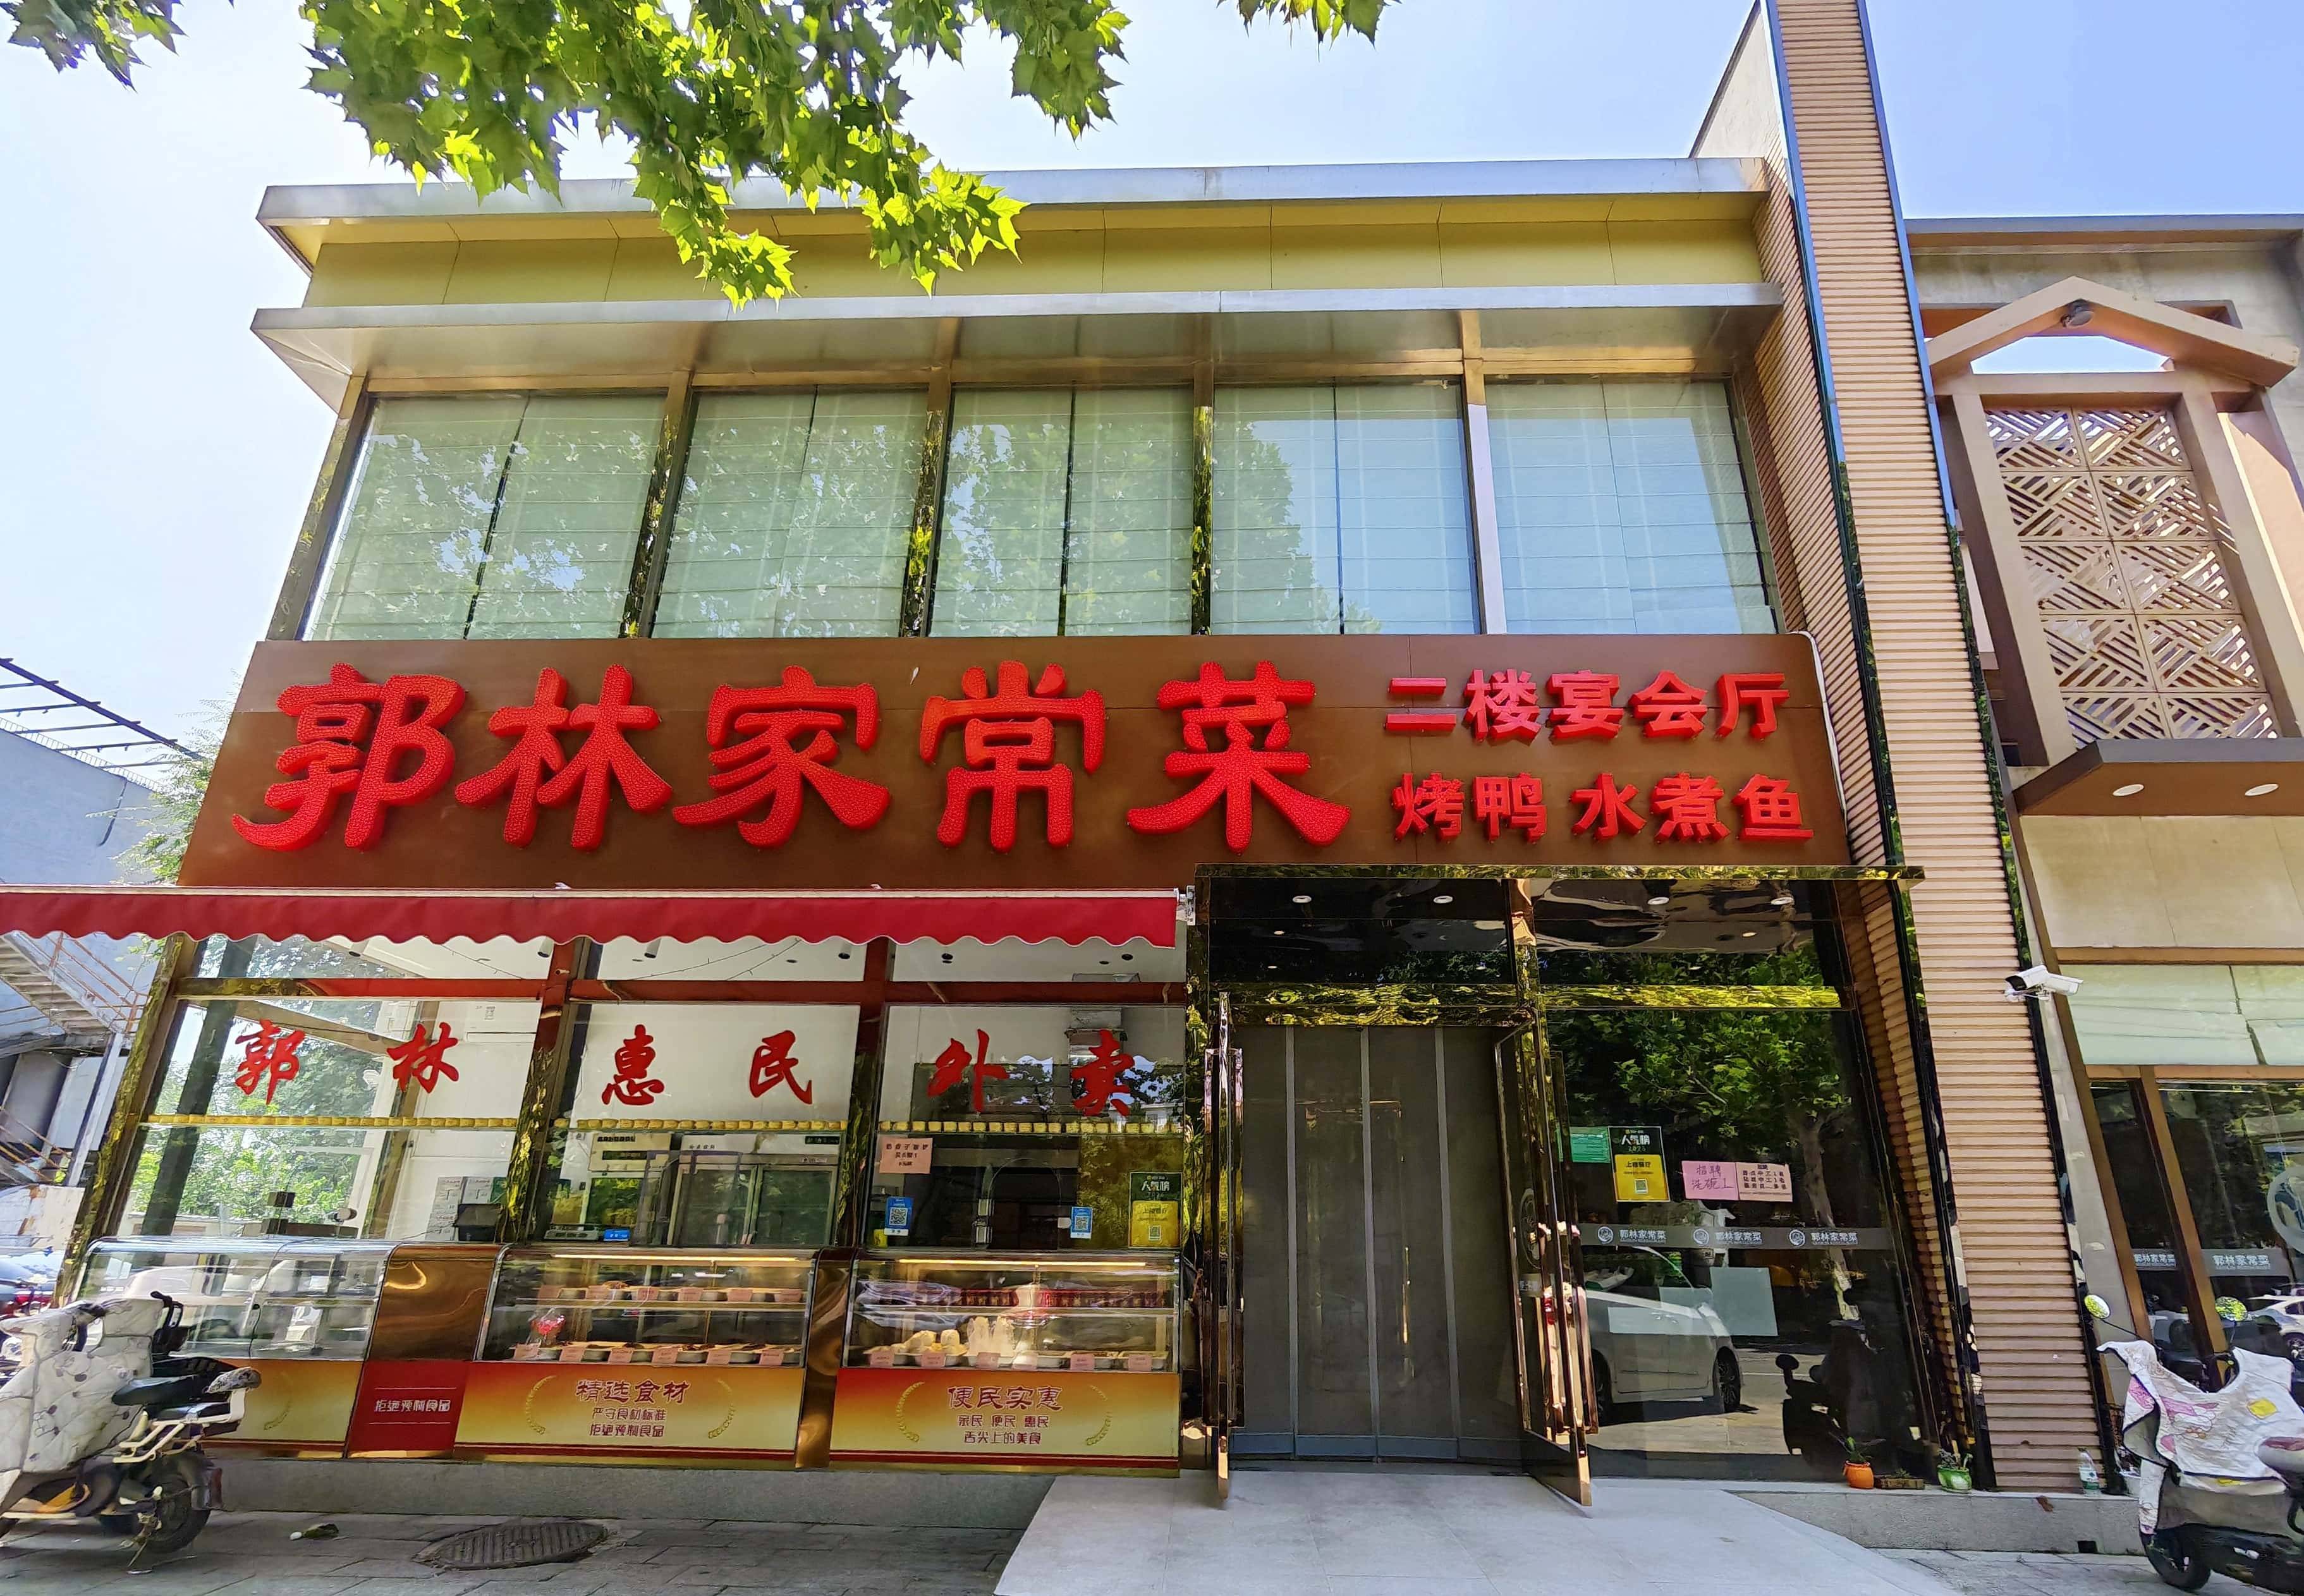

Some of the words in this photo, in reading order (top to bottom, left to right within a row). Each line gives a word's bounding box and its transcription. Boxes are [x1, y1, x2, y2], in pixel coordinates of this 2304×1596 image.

[1384, 669, 1790, 741] 二楼宴会厅
[232, 660, 1352, 853] 郭林家常菜
[1392, 772, 1549, 843] 烤鸭
[1569, 772, 1814, 842] 水煮鱼
[575, 1379, 691, 1404] 精选食材
[948, 1386, 1063, 1410] 便民实惠
[374, 1399, 451, 1412] 拒绝预制食品
[964, 1430, 1042, 1444] 舌尖上的美食
